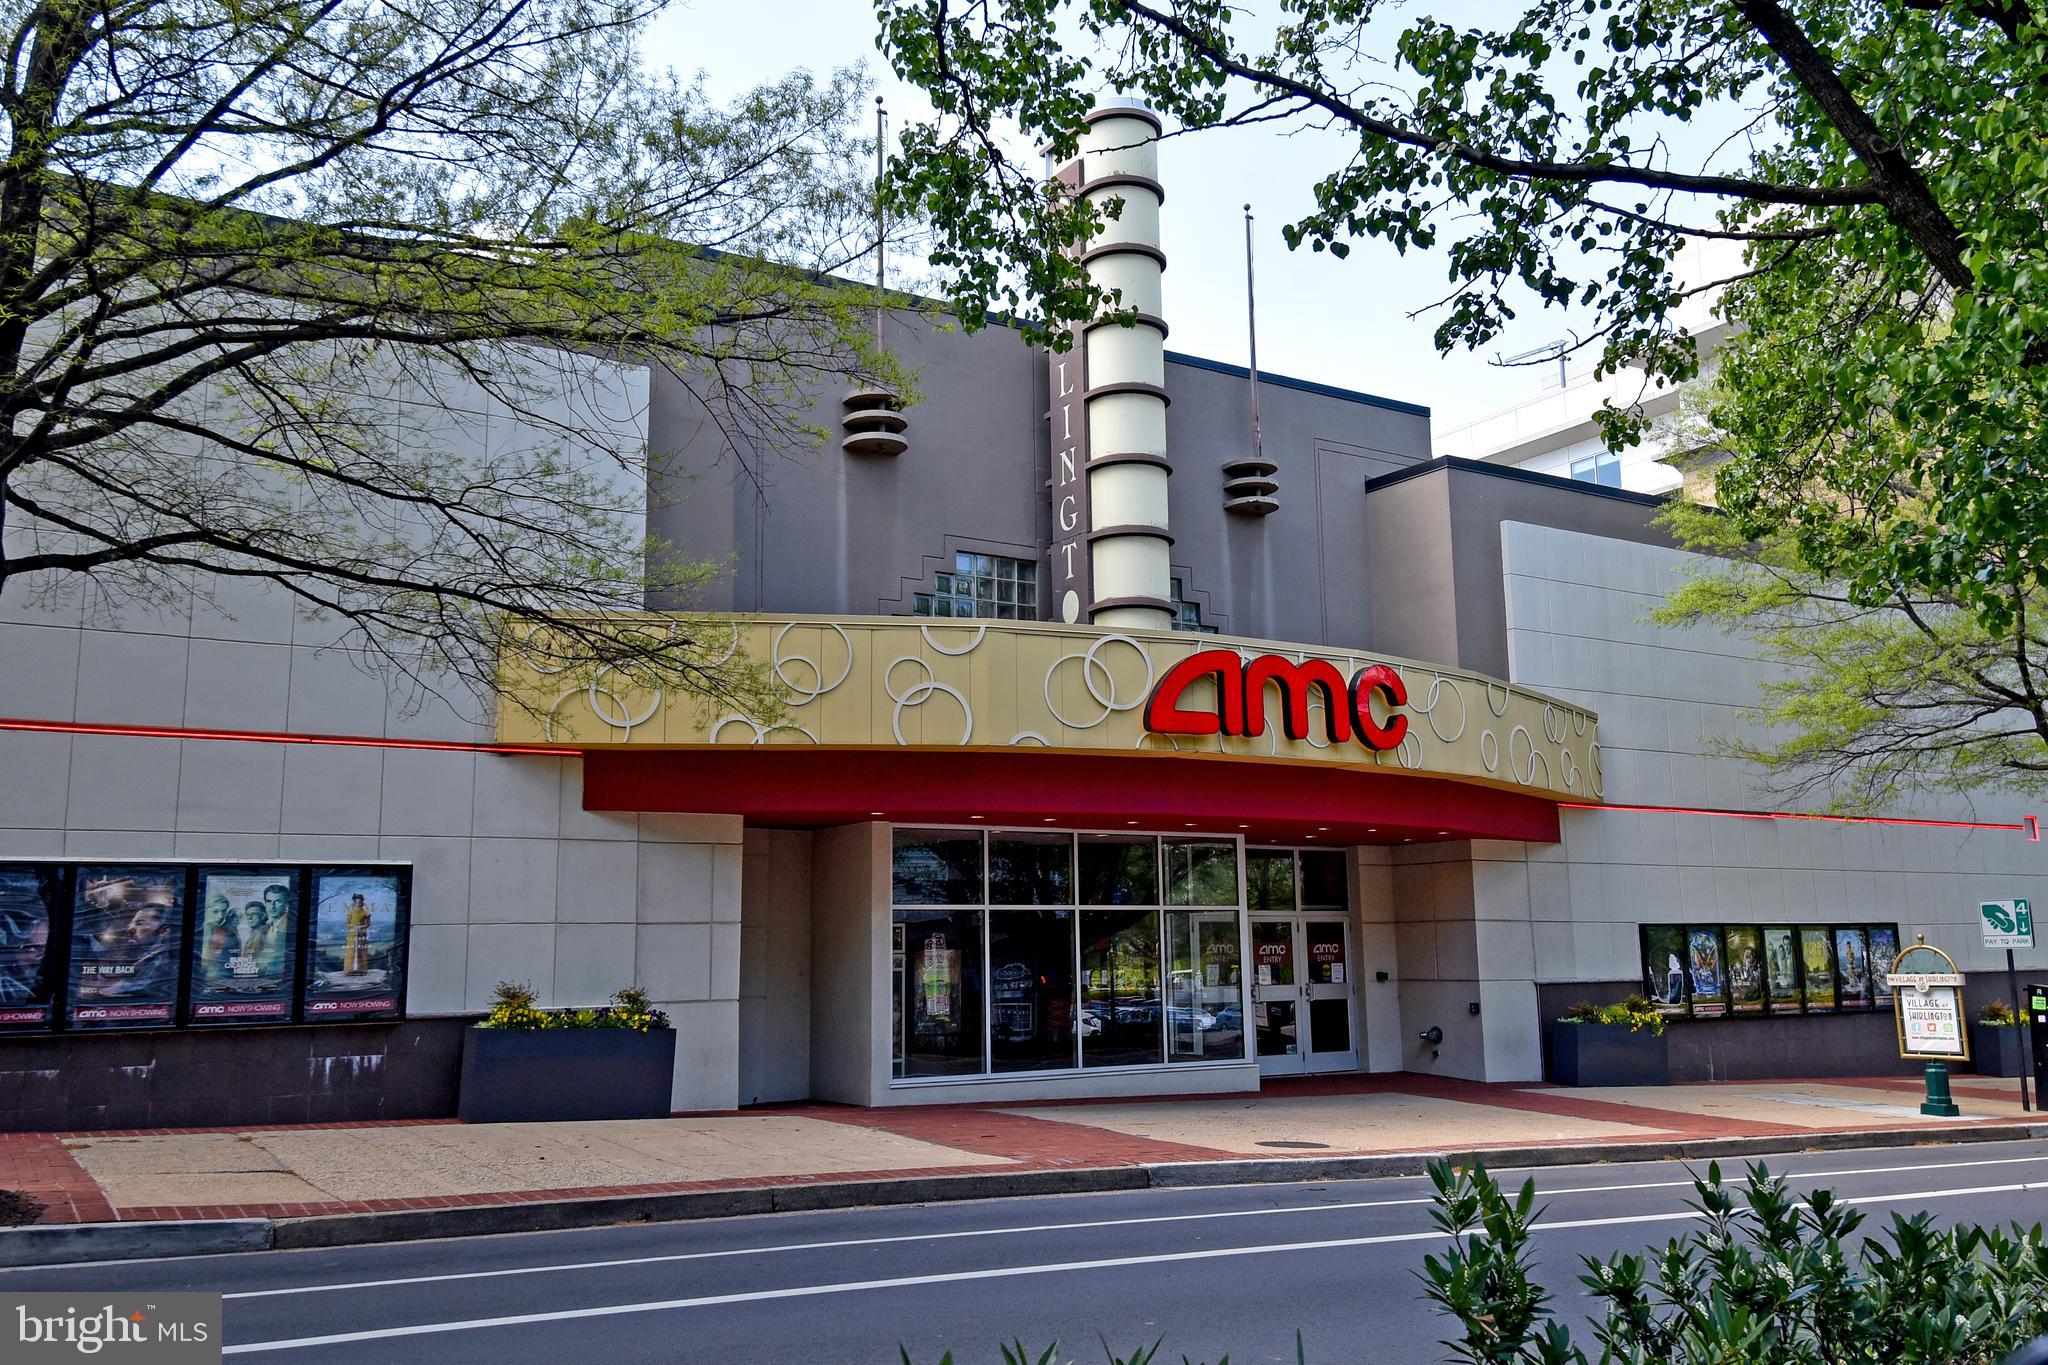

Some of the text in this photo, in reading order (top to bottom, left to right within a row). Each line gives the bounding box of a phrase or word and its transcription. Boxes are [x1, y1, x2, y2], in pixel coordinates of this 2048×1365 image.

[2016, 902, 2028, 915] 4
[1317, 954, 1335, 962] ENTRY
[82, 965, 135, 974] THE WAY BACK
[247, 1004, 281, 1012] SHOWING
[358, 1000, 391, 1008] SHOWING
[1906, 999, 1940, 1008] VILLAGE
[130, 1008, 167, 1017] SHOWING
[1908, 1011, 1953, 1021] SHIRLINGTON
